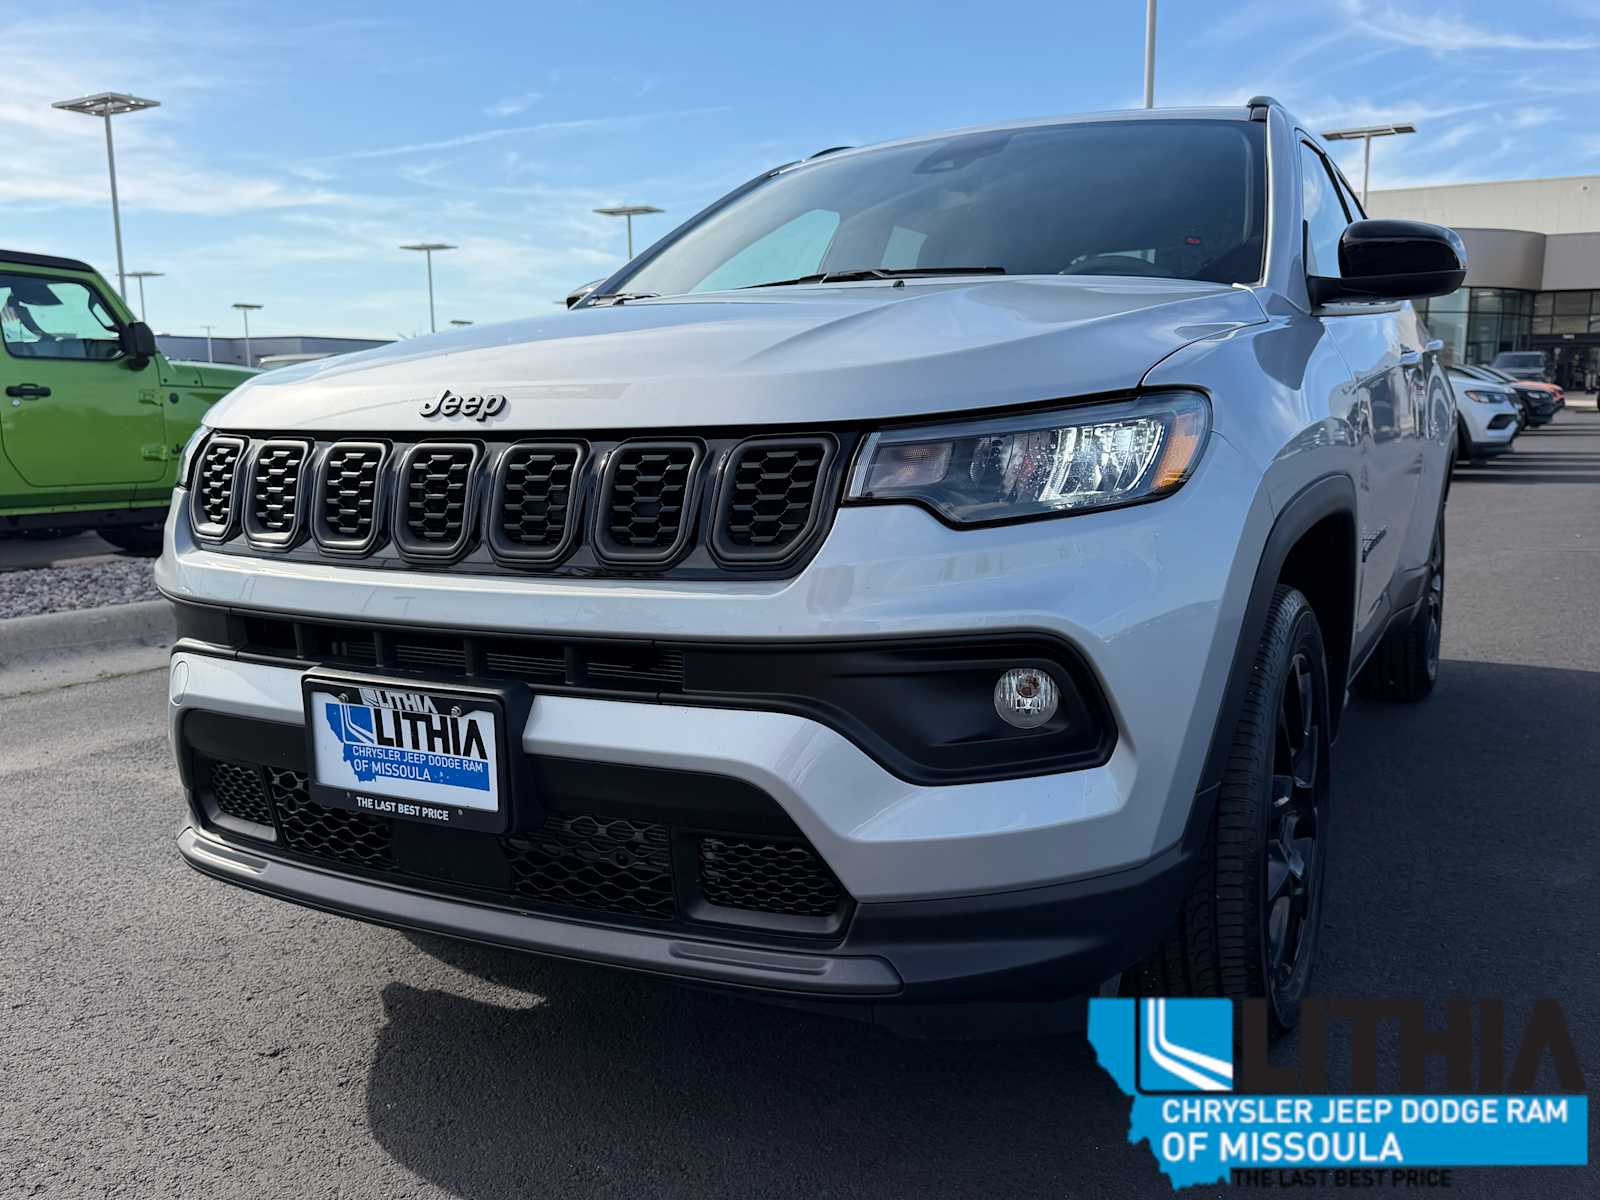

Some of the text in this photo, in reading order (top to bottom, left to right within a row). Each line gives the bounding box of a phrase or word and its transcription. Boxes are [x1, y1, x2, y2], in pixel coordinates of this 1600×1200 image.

[419, 389, 507, 422] Jeep
[376, 688, 438, 714] LITHIA
[374, 708, 488, 760] LITHIA
[352, 745, 483, 773] CHRYSLER JEEP DODGE RAM
[353, 758, 431, 781] OF MISSOULA
[356, 796, 449, 821] THE LAST BEST PRICE
